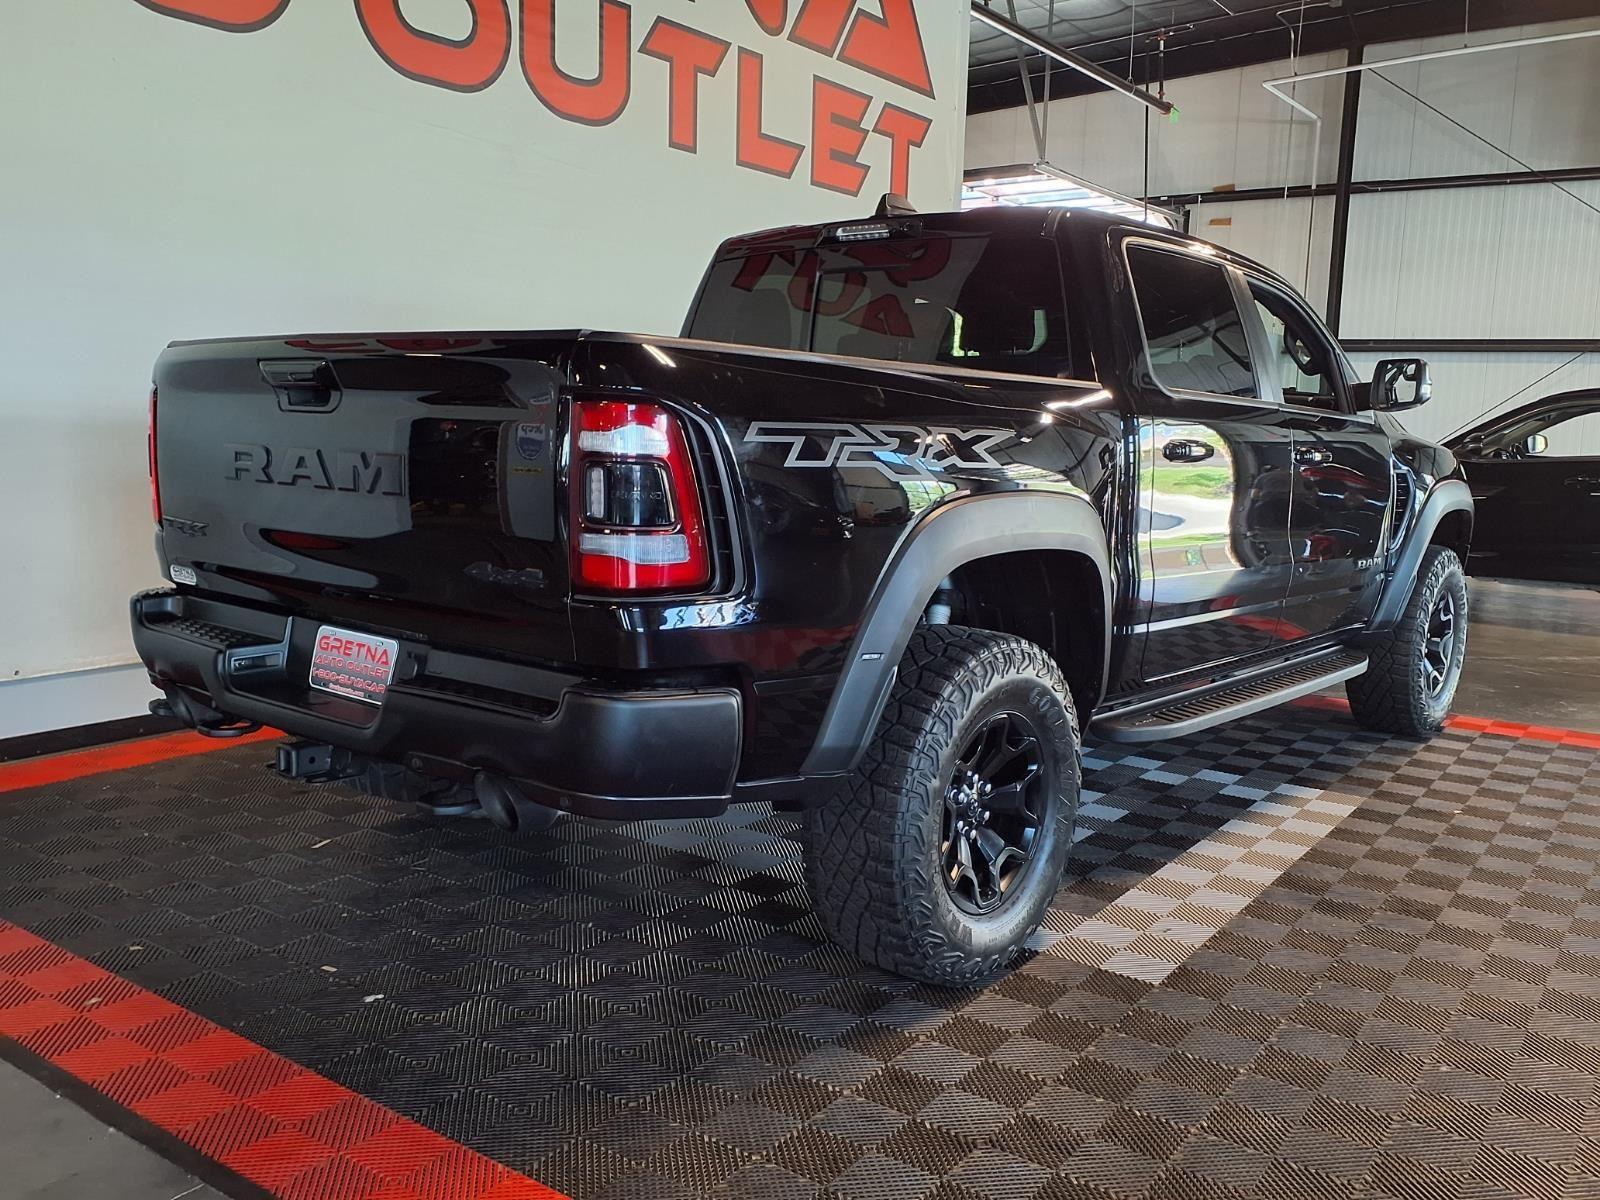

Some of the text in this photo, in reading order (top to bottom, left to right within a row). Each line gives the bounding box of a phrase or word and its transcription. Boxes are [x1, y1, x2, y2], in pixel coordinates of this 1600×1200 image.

[743, 421, 1018, 481] TRX
[223, 442, 406, 497] RAM
[1357, 557, 1381, 570] RAM
[319, 635, 389, 666] GRETNA
[314, 654, 390, 679] AUTO OUTLET
